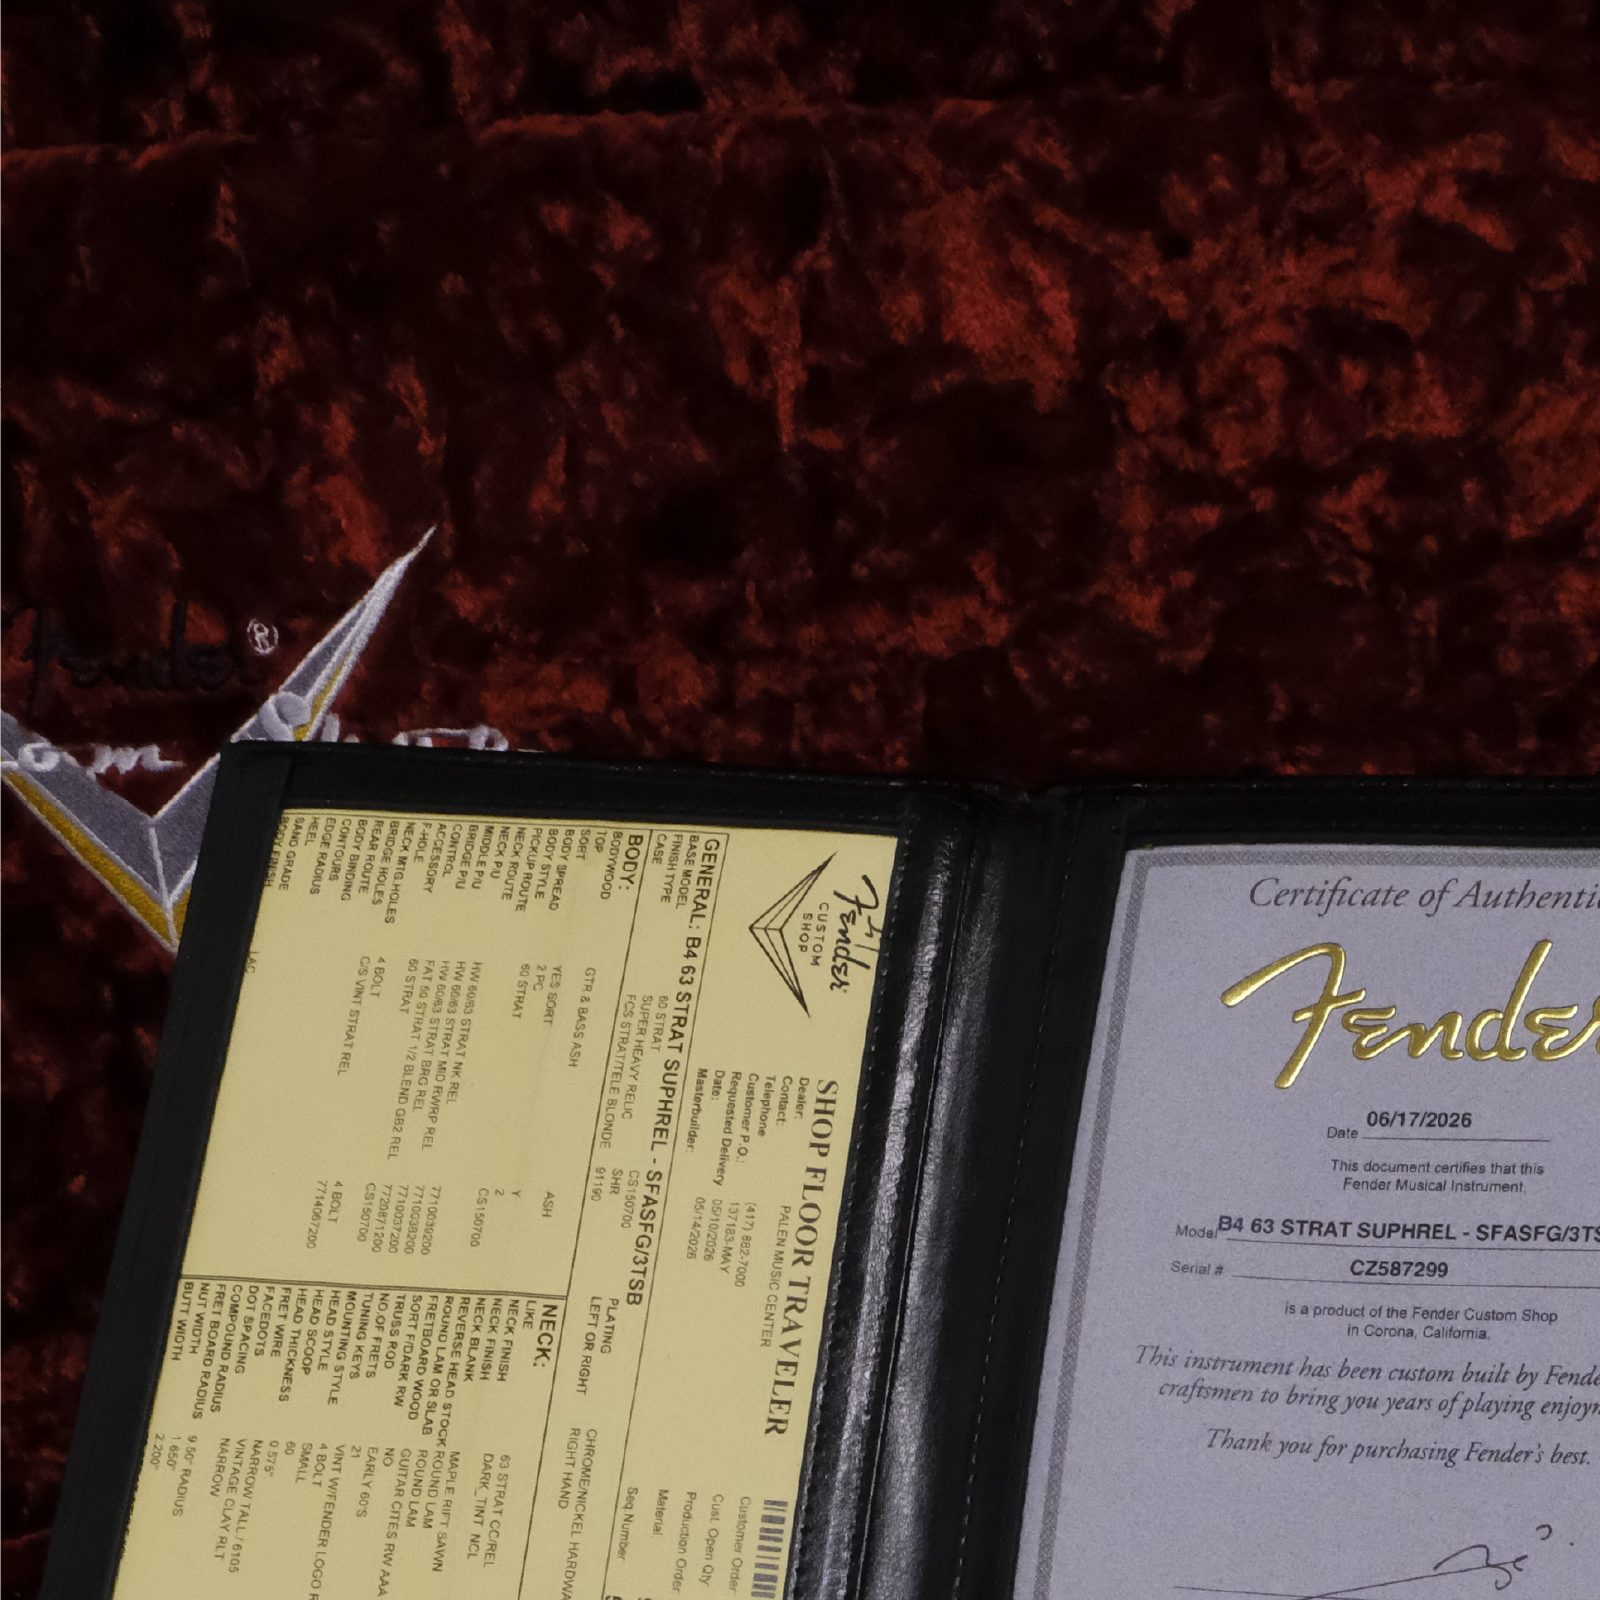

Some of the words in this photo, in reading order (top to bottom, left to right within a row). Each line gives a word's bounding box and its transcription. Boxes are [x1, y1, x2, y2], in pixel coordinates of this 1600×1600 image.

[618, 834, 643, 890] BODY:
[687, 838, 720, 929] GENERAL:
[1249, 874, 1410, 918] Certificate
[1418, 877, 1458, 917] of
[682, 936, 701, 959] B4
[797, 912, 813, 952] SHOP
[809, 901, 829, 966] CUSTOM
[678, 965, 696, 985] 63
[666, 990, 692, 1053] STRAT
[650, 1058, 680, 1151] SUPHREL
[710, 1069, 725, 1100] Date:
[722, 1071, 742, 1134] Requested
[741, 1072, 759, 1132] Customer
[757, 1075, 776, 1137] Telephone
[775, 1075, 793, 1125] Contact:
[793, 1076, 810, 1119] Dealer:
[685, 1067, 708, 1152] Masterbuilder:
[808, 1079, 839, 1157] SHOP
[1326, 1126, 1358, 1139] Date
[1366, 1110, 1472, 1128] 06/17/2026
[712, 1137, 732, 1186] Delivery
[1330, 1158, 1358, 1171] This
[1362, 1159, 1430, 1173] document
[1434, 1161, 1485, 1174] certifies
[1490, 1161, 1516, 1174] that
[1519, 1162, 1544, 1175] this
[1342, 1176, 1391, 1191] Fender
[1395, 1178, 1447, 1191] Musical
[625, 1169, 663, 1305] SFASFG/3TSB
[686, 1196, 705, 1259] 05/14/2026
[702, 1198, 722, 1261] 05/10/2026
[741, 1201, 757, 1231] (417)
[775, 1204, 791, 1247] PALEN
[790, 1166, 827, 1267] FLOOR
[1174, 1219, 1219, 1239] Model
[1217, 1214, 1243, 1232] B4
[1250, 1217, 1274, 1234] 63
[1280, 1218, 1353, 1237] STRAT
[1356, 1221, 1457, 1240] SUPHREL
[734, 1234, 752, 1287] 882-7000
[768, 1250, 784, 1290] MUSIC
[1170, 1260, 1211, 1275] Serial
[1213, 1263, 1224, 1276] #
[1349, 1258, 1448, 1278] CZ587299
[532, 1304, 558, 1367] NECK:
[599, 1297, 619, 1354] PLATING
[759, 1294, 778, 1347] CENTER
[1284, 1299, 1296, 1315] is
[1299, 1304, 1309, 1315] a
[1311, 1304, 1365, 1318] product
[1368, 1304, 1383, 1318] of
[1385, 1306, 1407, 1319] the
[1411, 1305, 1460, 1320] Fender
[1463, 1307, 1517, 1321] Custom
[1521, 1308, 1558, 1325] Shop
[1346, 1323, 1359, 1336] in
[1363, 1323, 1416, 1339] Corona,
[764, 1275, 811, 1435] TRAVELER
[1134, 1344, 1178, 1366] This
[1183, 1355, 1294, 1375] instrument
[1298, 1355, 1331, 1377] has
[1337, 1357, 1382, 1380] been
[1387, 1366, 1454, 1382] custom
[1461, 1361, 1510, 1383] built
[1515, 1362, 1539, 1391] by
[1158, 1377, 1253, 1404] craftsmen
[1259, 1388, 1279, 1404] to
[1285, 1383, 1338, 1414] bring
[1342, 1395, 1379, 1414] you
[1380, 1396, 1432, 1416] years
[1437, 1390, 1464, 1419] of
[1457, 1390, 1536, 1421] playing
[242, 1439, 263, 1499] NARROW
[499, 1453, 511, 1468] 63
[1206, 1427, 1272, 1452] Thank
[1272, 1440, 1313, 1459] you
[1312, 1434, 1347, 1462] for
[1348, 1437, 1460, 1468] purchasing
[1463, 1440, 1544, 1463] Fender’s
[1549, 1442, 1590, 1465] best.
[492, 1472, 509, 1516] STRAT
[570, 1428, 598, 1537] CHROME/NICKEL
[235, 1502, 251, 1533] TALL
[677, 1491, 697, 1554] Production
[733, 1495, 751, 1554] Customer
[482, 1519, 500, 1568] CC/REL
[704, 1527, 719, 1560] Open
